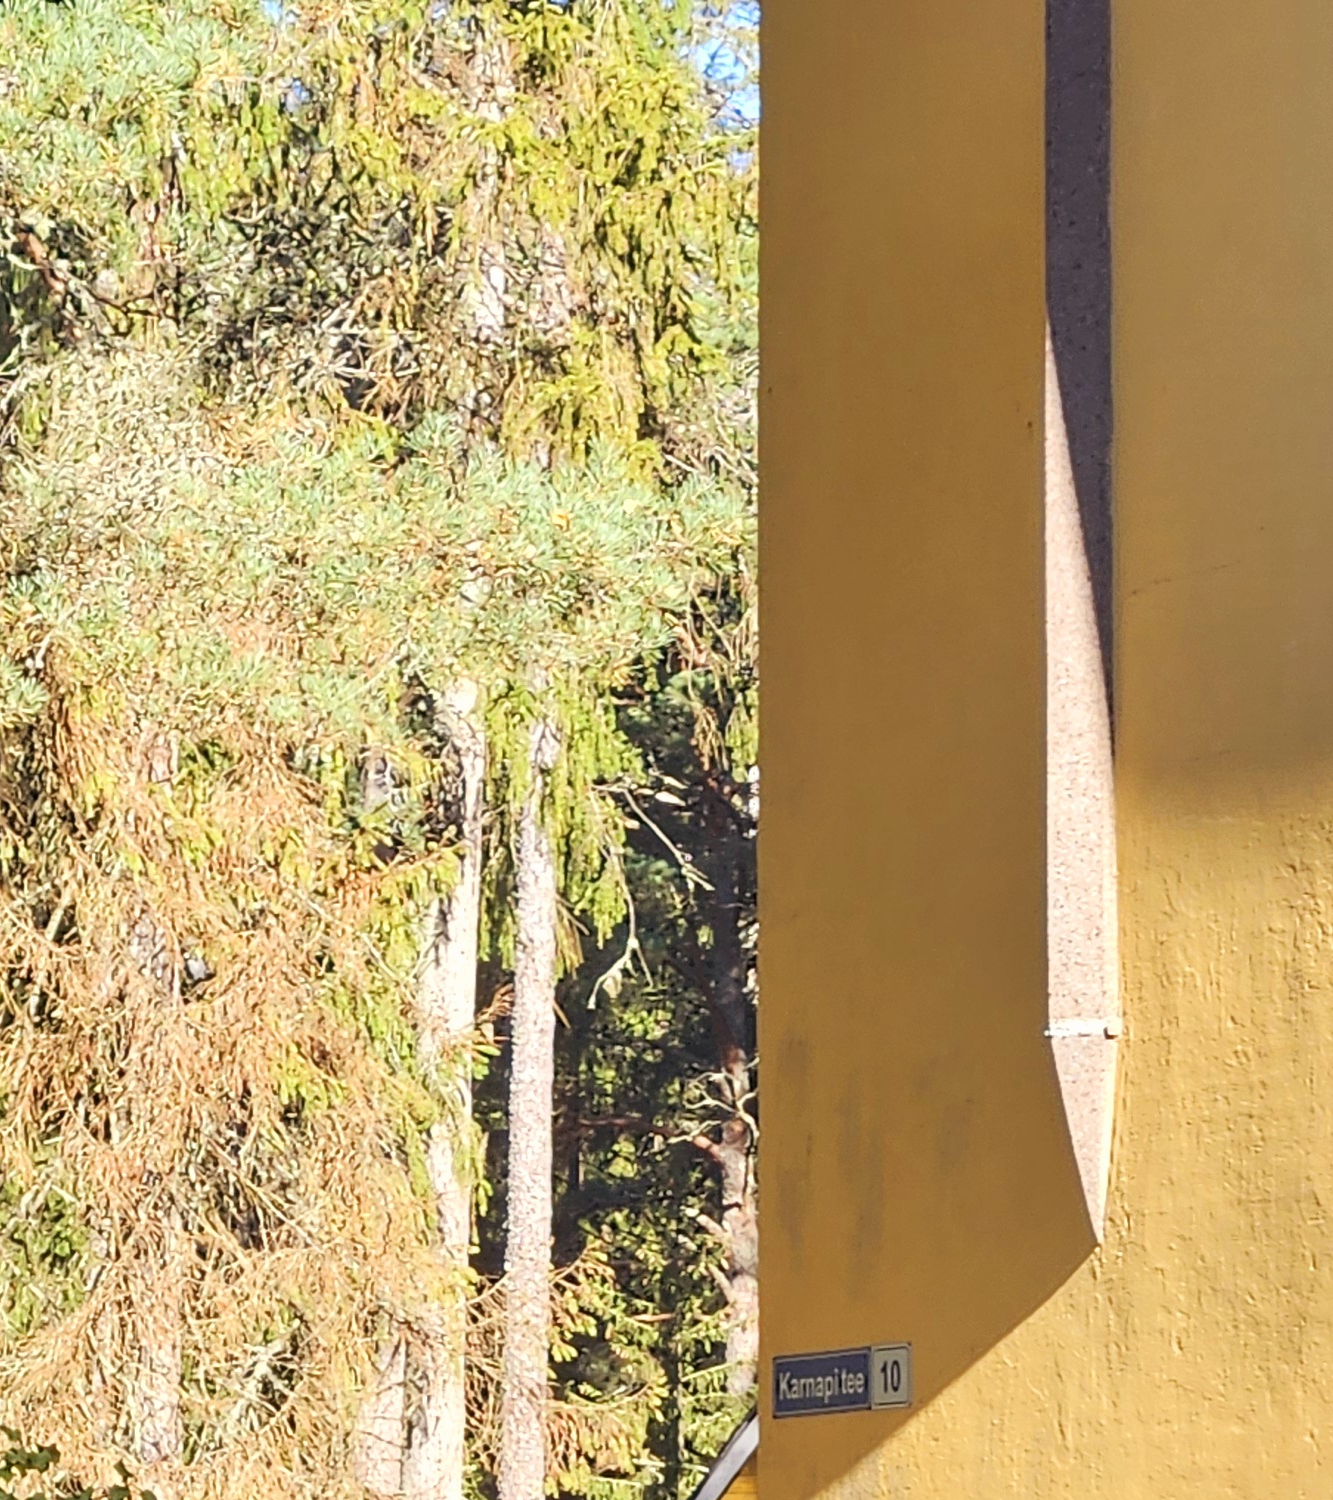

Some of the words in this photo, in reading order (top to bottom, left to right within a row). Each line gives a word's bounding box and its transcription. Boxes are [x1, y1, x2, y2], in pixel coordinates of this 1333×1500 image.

[779, 1367, 839, 1403] Karnapi
[841, 1368, 865, 1394] tee
[880, 1360, 901, 1393] 10
